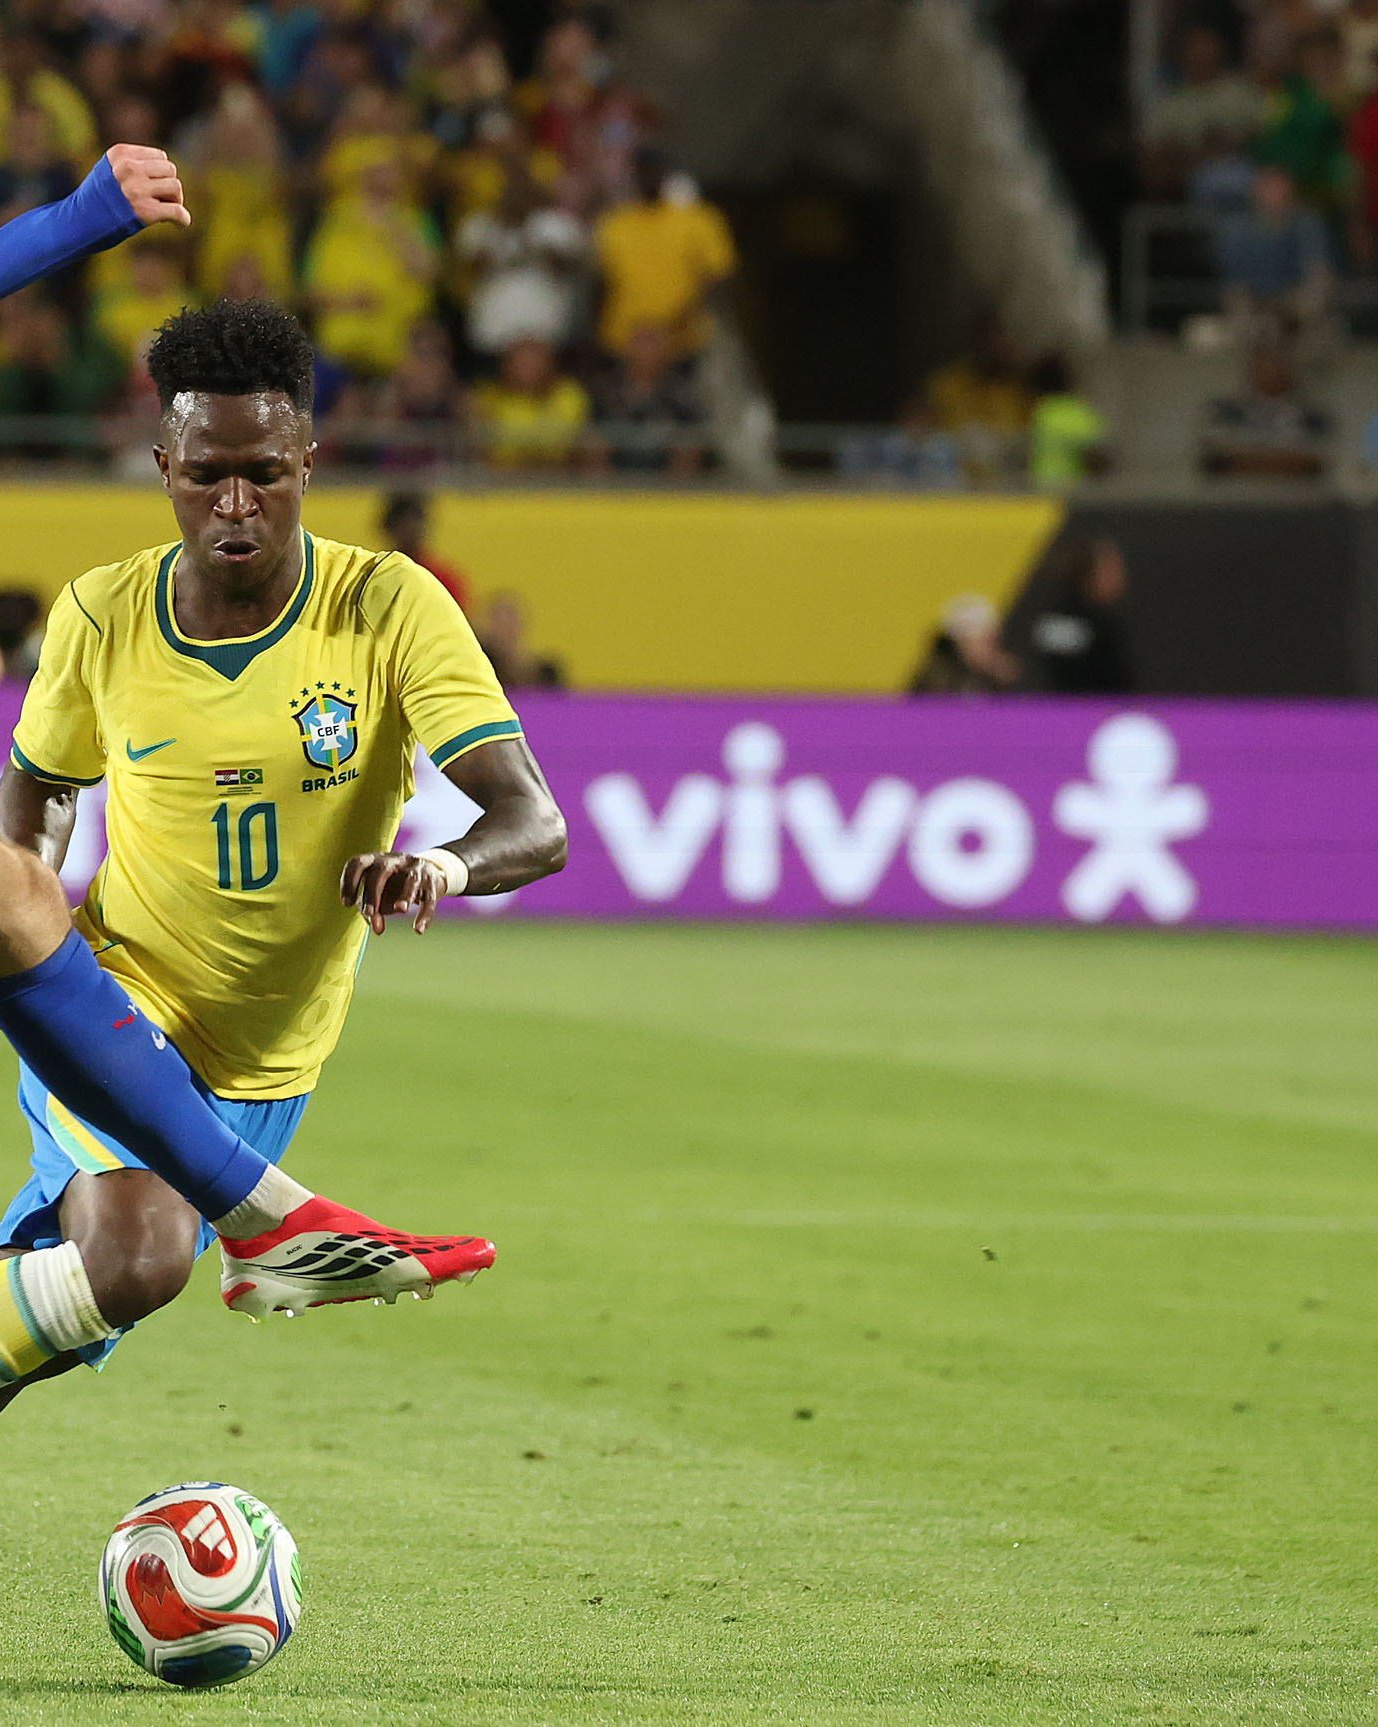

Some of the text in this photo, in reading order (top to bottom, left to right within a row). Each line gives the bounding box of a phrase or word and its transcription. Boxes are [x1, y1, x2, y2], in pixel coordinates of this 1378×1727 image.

[317, 725, 340, 737] CBF
[302, 768, 359, 792] BRASIL
[584, 721, 1036, 908] vivo
[210, 801, 279, 891] 10
